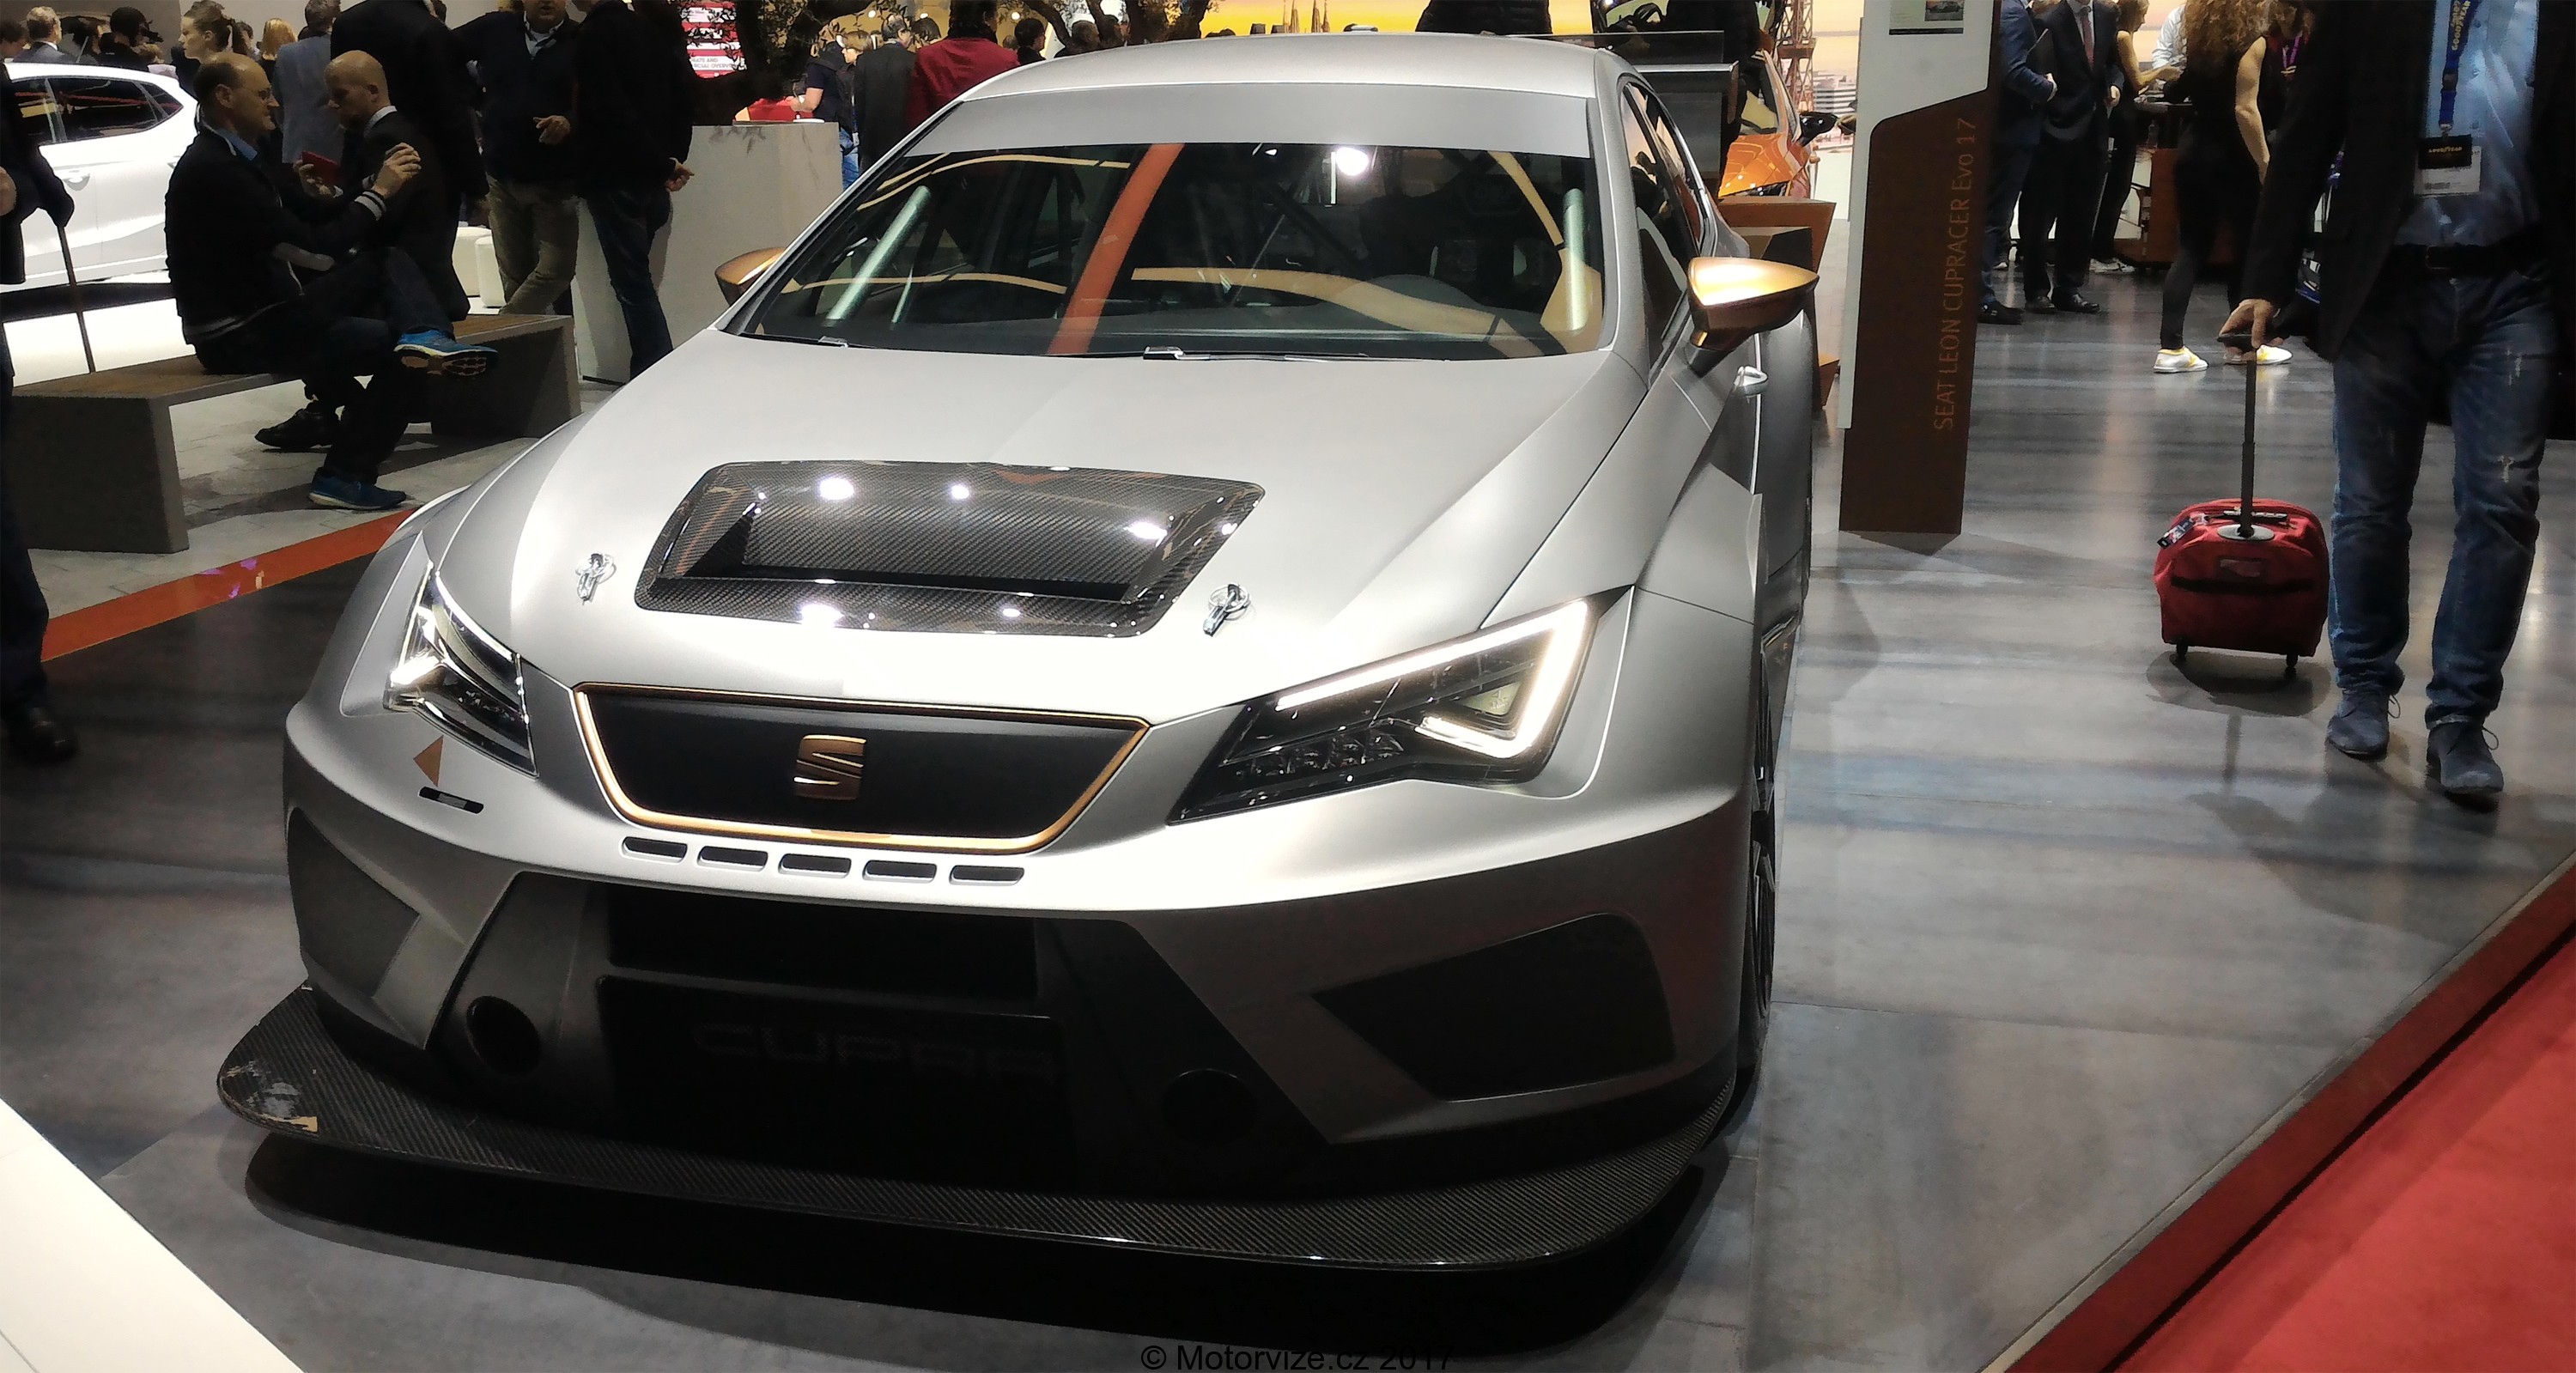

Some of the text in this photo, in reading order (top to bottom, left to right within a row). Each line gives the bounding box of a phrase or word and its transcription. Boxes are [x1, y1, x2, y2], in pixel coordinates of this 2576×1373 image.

[1956, 118, 1976, 145] 17
[1942, 198, 1971, 312] CUPRACER
[1939, 319, 1962, 374] LEON
[1933, 379, 1956, 430] SEAT
